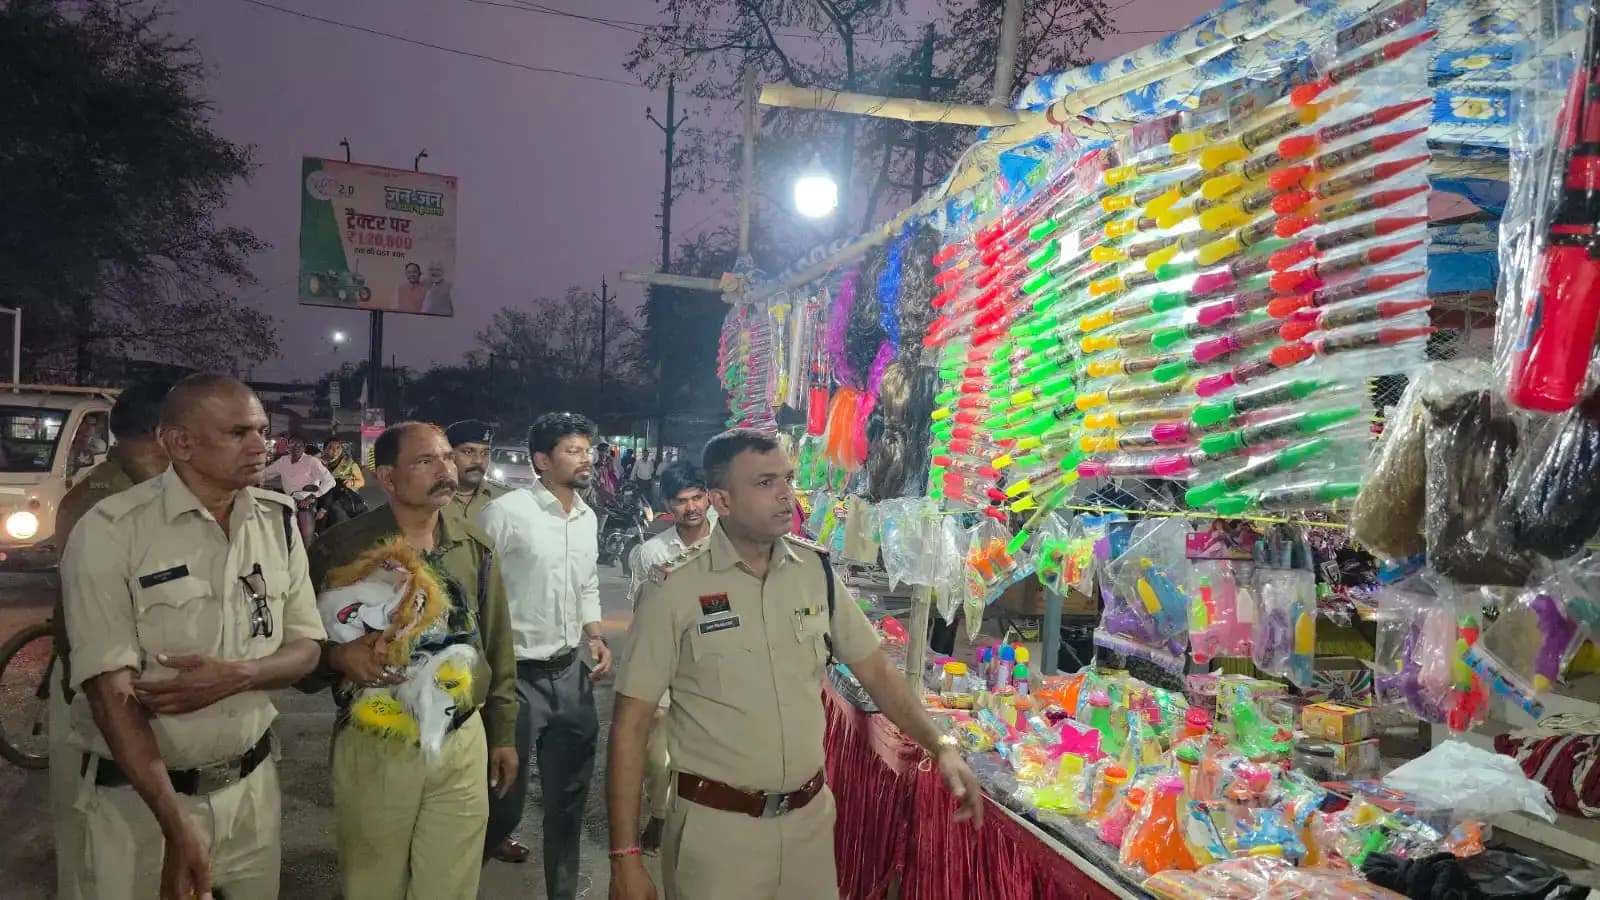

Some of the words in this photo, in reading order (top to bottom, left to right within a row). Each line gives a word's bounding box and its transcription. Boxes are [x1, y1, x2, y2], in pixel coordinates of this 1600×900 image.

[338, 184, 355, 195] 2.0
[389, 216, 413, 234] पर
[376, 249, 390, 257] GST
